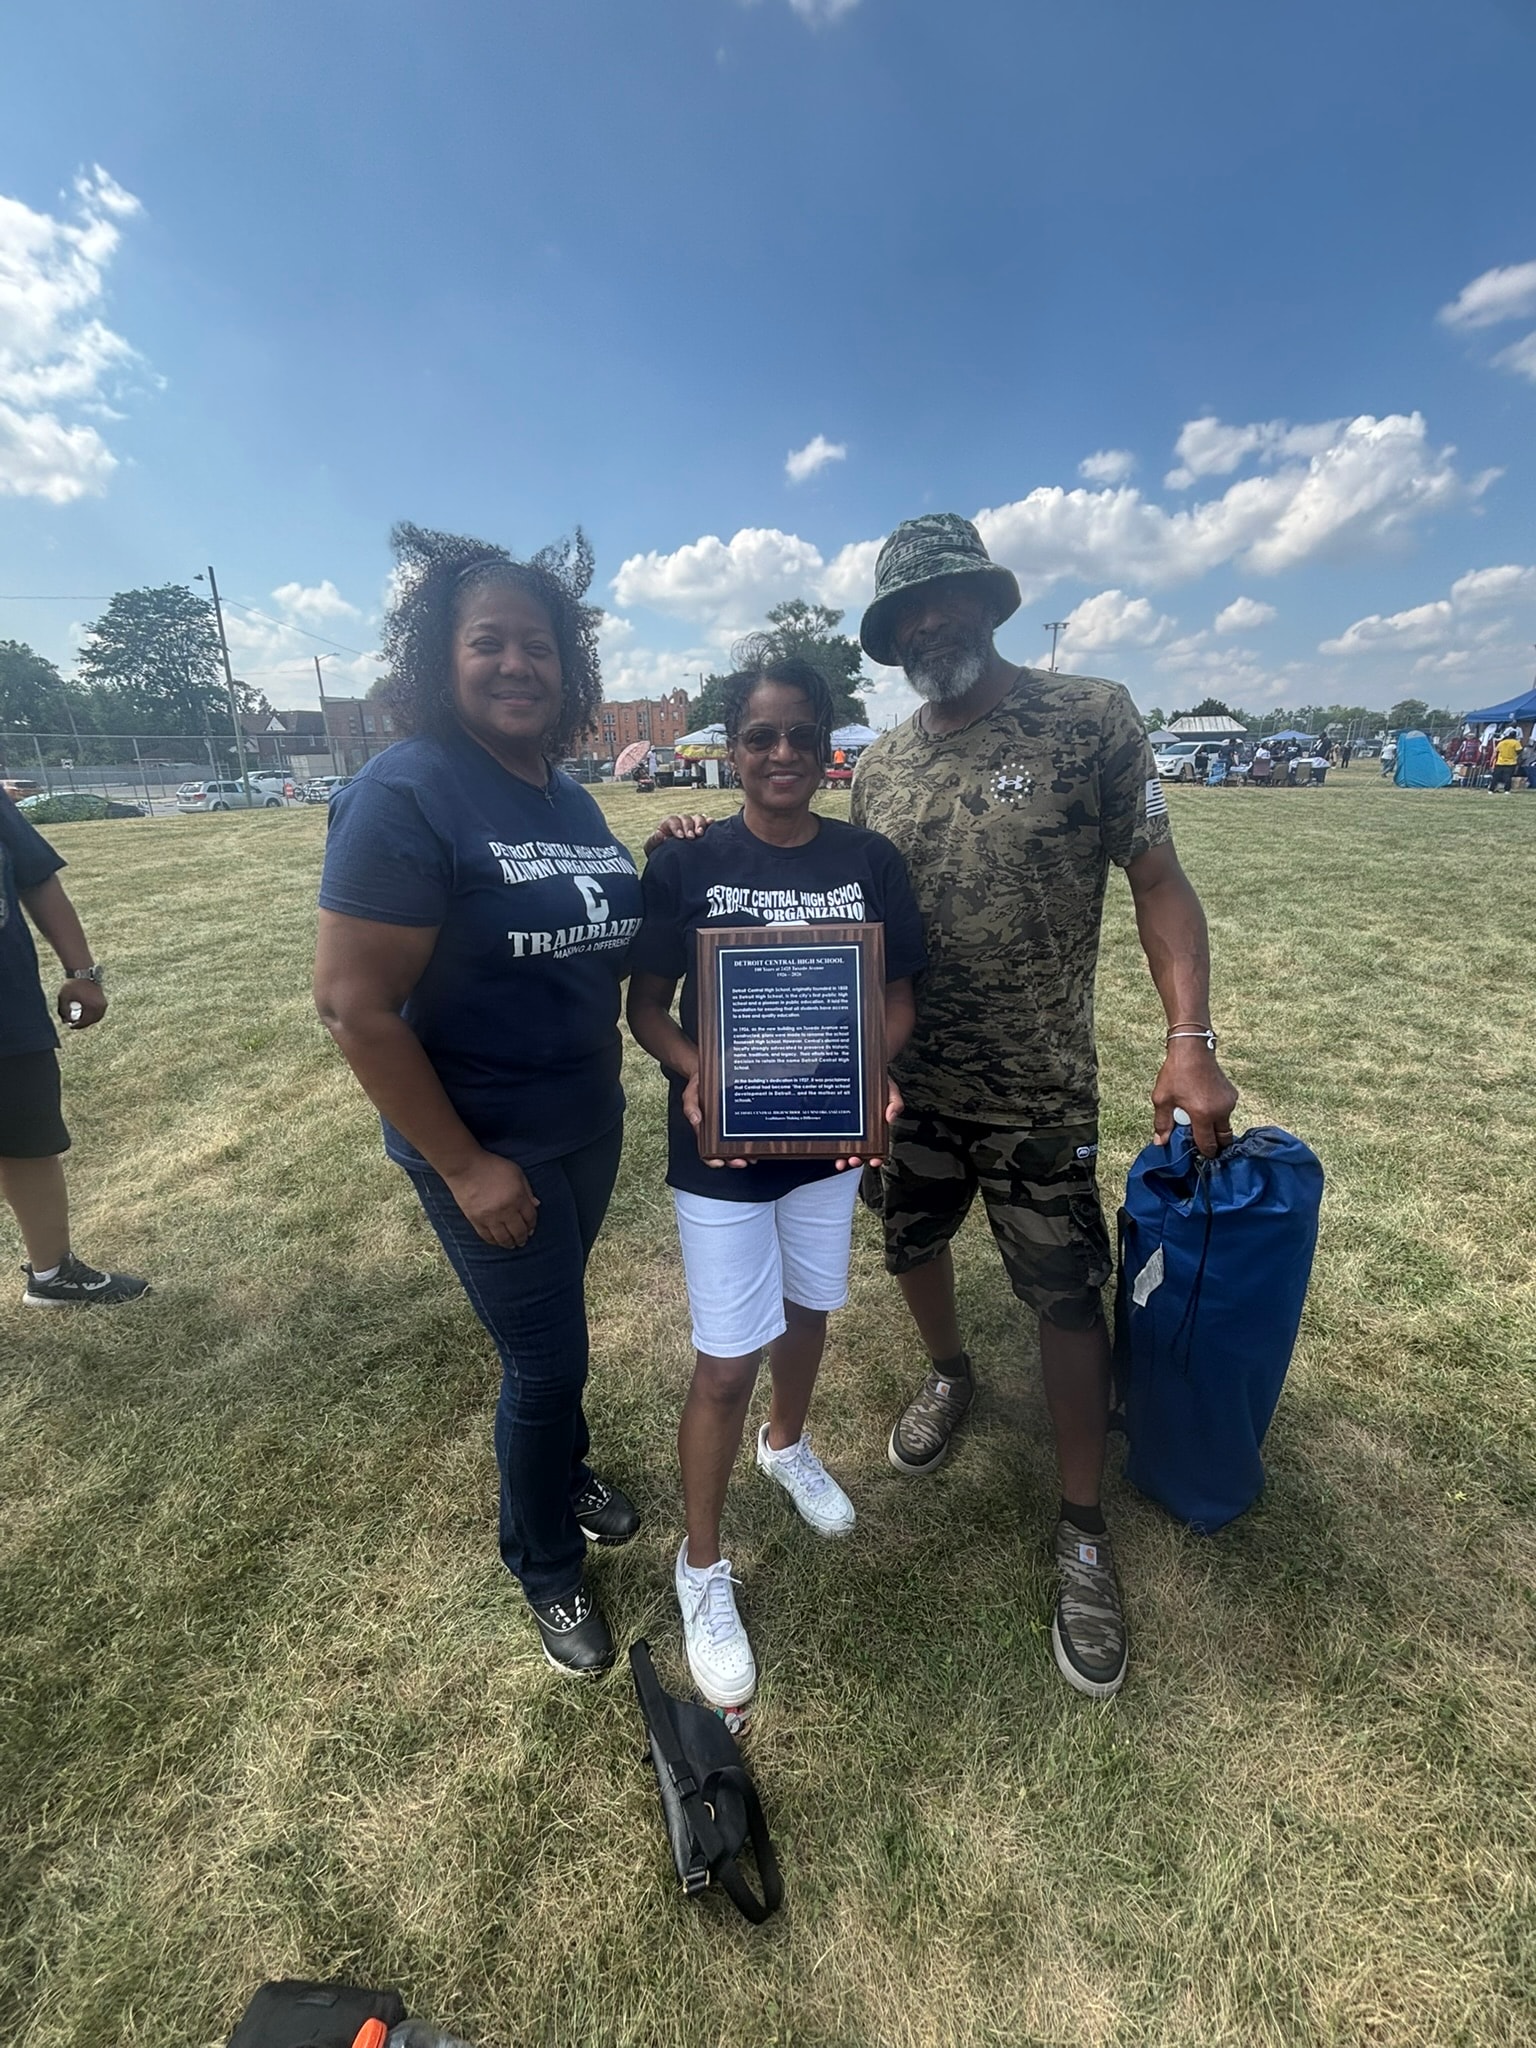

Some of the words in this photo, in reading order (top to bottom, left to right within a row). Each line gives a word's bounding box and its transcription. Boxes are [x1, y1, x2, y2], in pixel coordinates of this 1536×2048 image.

[488, 842, 537, 859] DETROIT
[536, 841, 577, 858] CENTRAL
[572, 845, 597, 859] HIGH
[499, 859, 558, 884] ALUMNI
[574, 875, 610, 923] C
[706, 885, 751, 907] DETROIT
[751, 889, 799, 908] CENTRAL
[800, 891, 826, 907] HIGH
[827, 882, 865, 906] SCHOO
[762, 901, 866, 922] ORGANIZATIO
[553, 943, 585, 959] MAKING
[585, 944, 592, 952] A
[593, 937, 631, 952] DIFFERENCE
